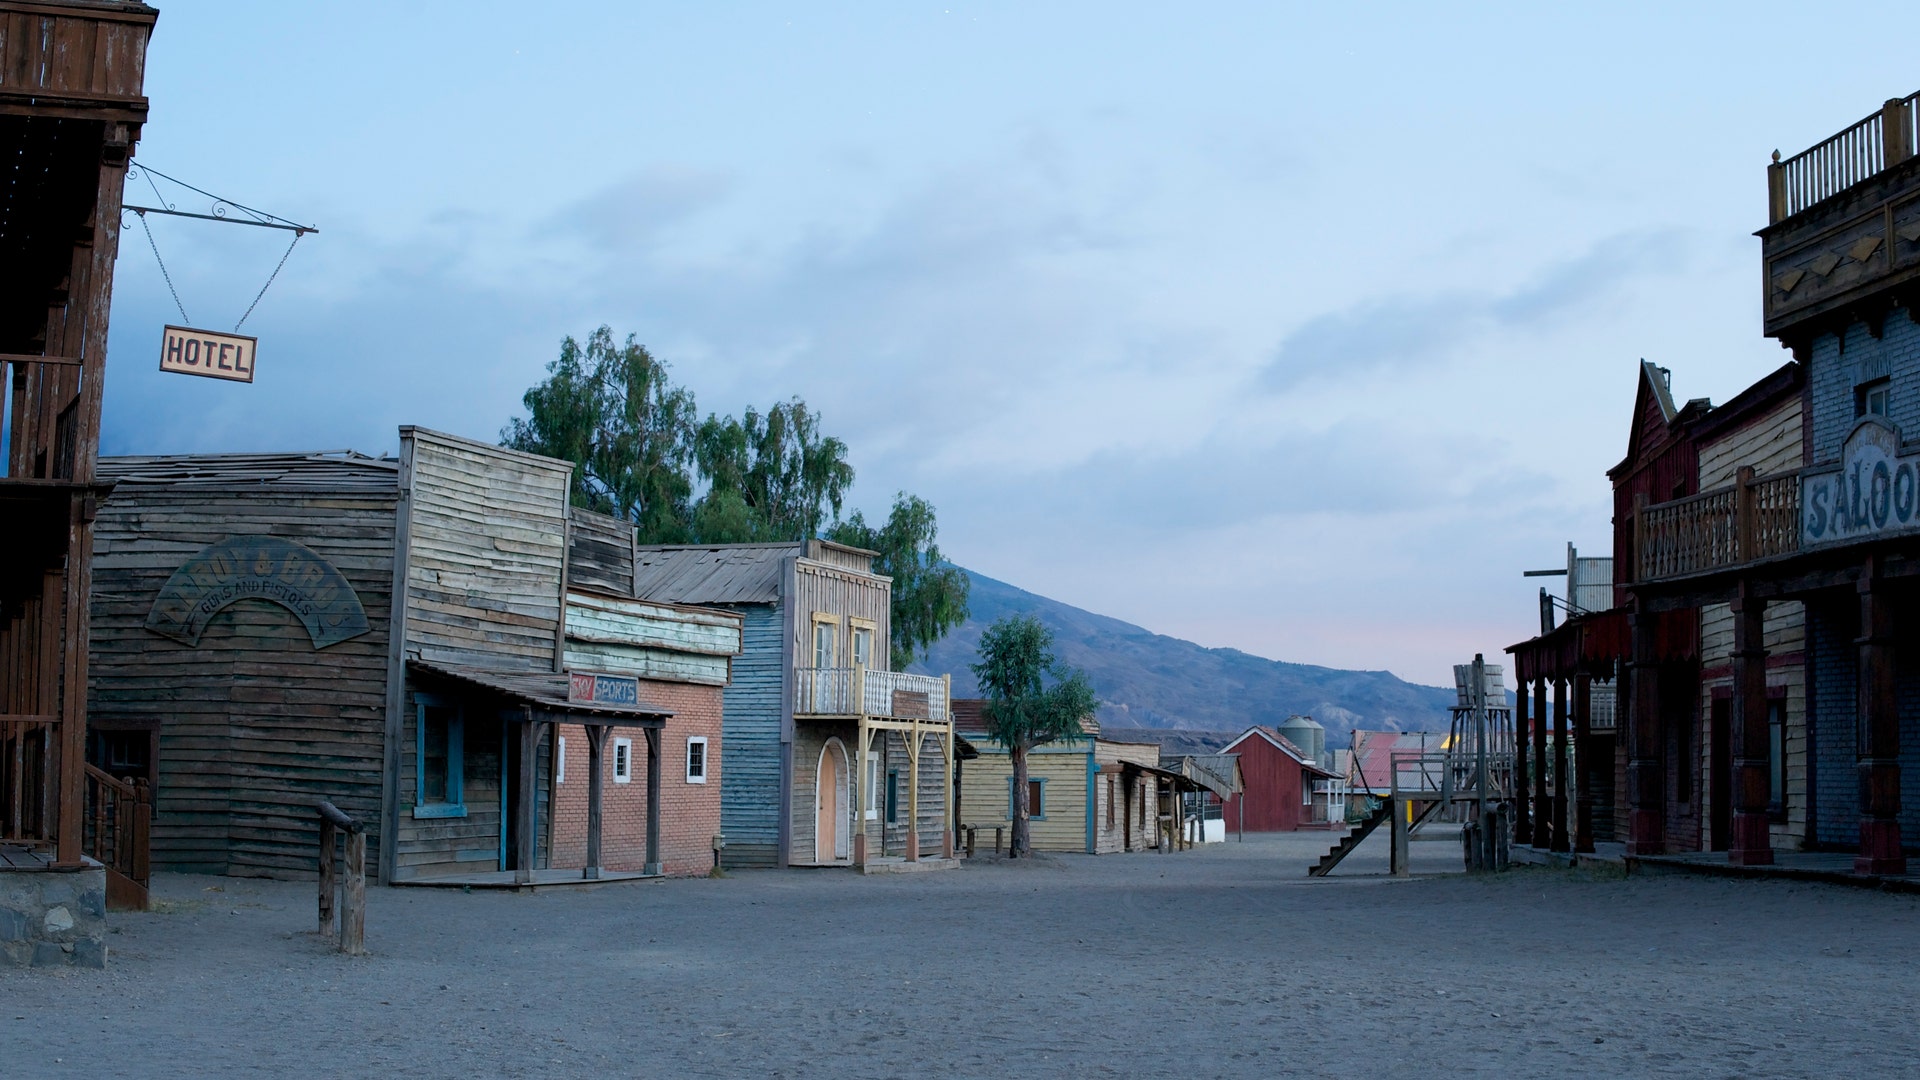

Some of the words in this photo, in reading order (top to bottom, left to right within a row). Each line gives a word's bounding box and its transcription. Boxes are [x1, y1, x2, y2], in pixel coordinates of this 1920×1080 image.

[167, 335, 249, 373] HOTEL
[1807, 459, 1920, 538] SALOO
[254, 549, 275, 578] &
[201, 584, 232, 615] GUNS
[235, 581, 260, 596] AND
[262, 580, 312, 617] PISTOLS
[595, 680, 635, 701] SPORTS
